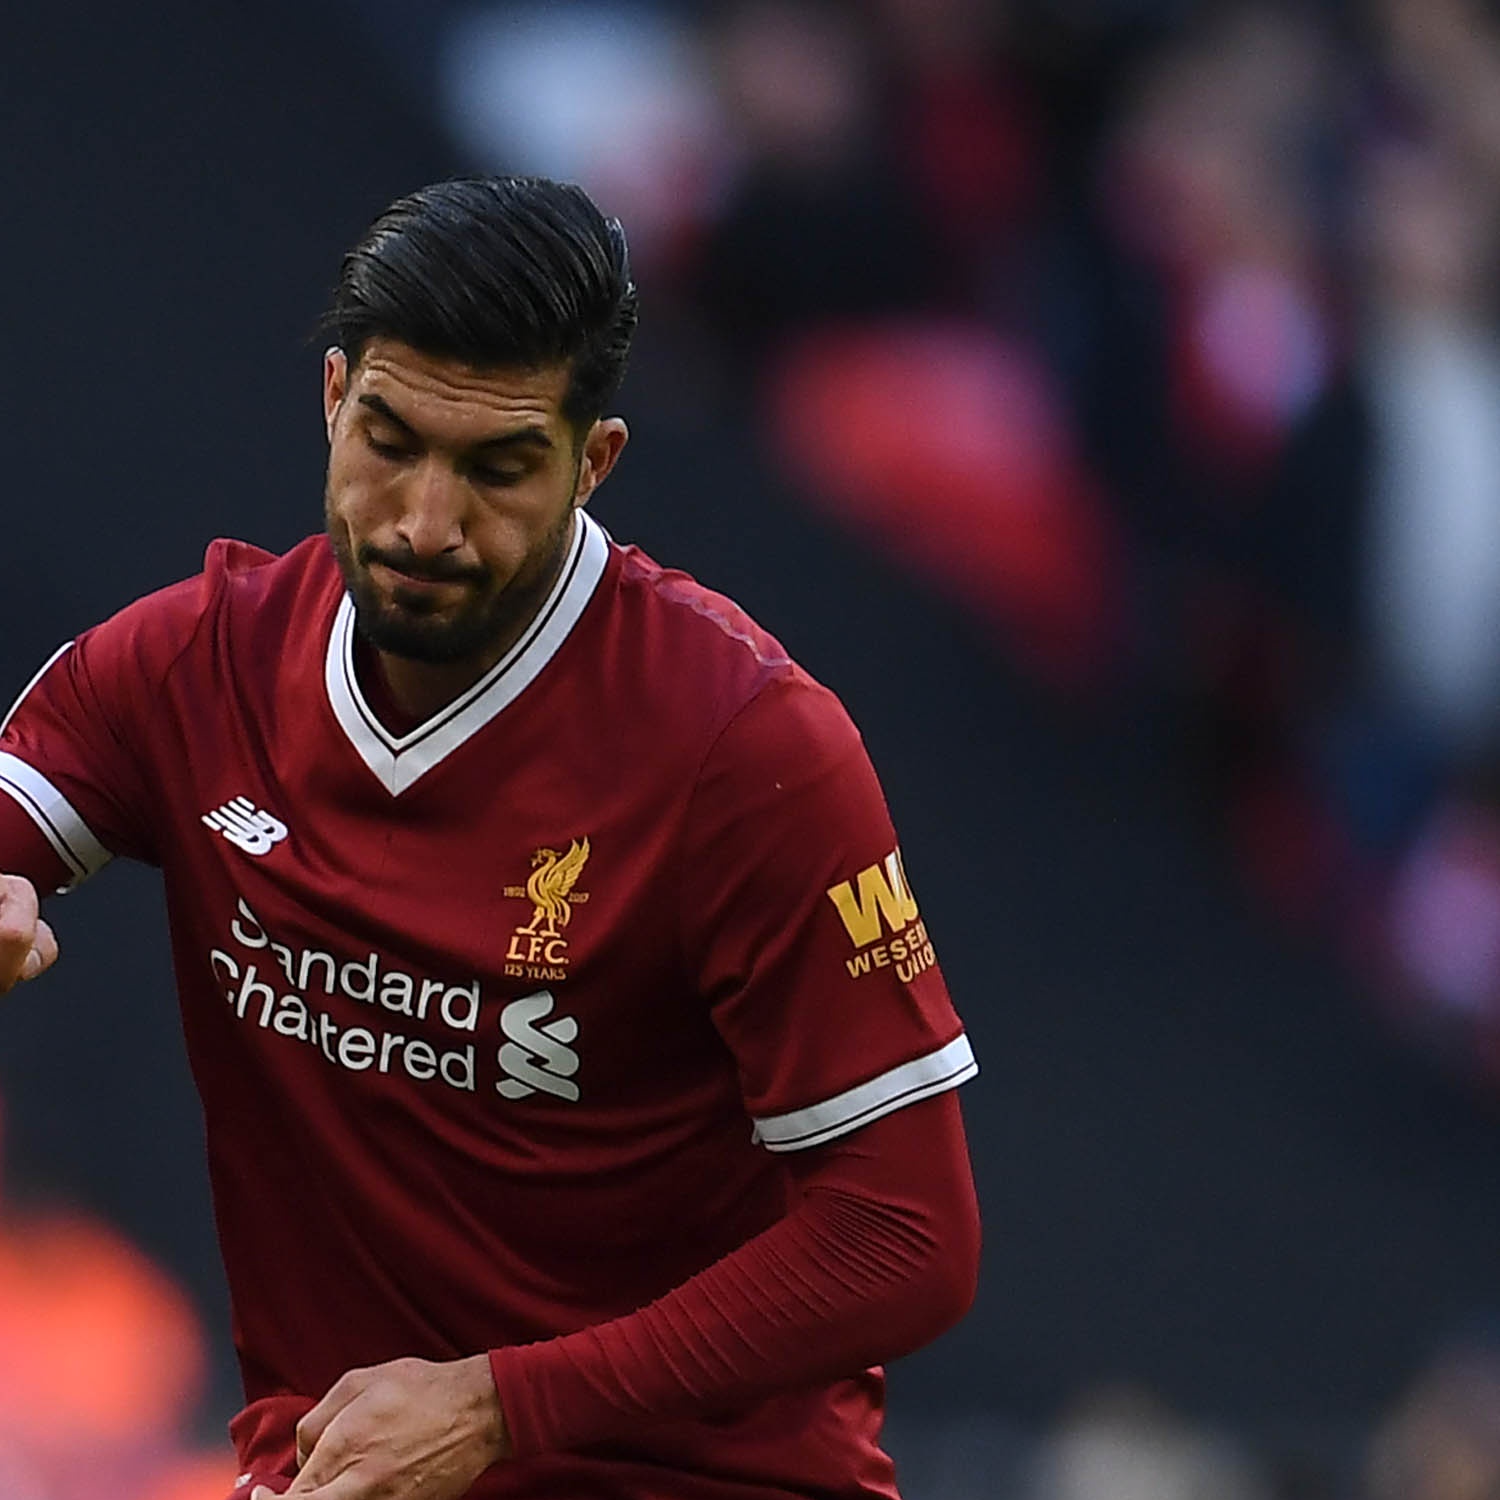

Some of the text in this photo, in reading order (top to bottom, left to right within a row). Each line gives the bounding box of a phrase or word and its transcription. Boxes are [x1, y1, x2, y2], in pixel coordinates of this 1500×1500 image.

[231, 897, 480, 1032] Sandard
[504, 964, 568, 981] 125 YEARS
